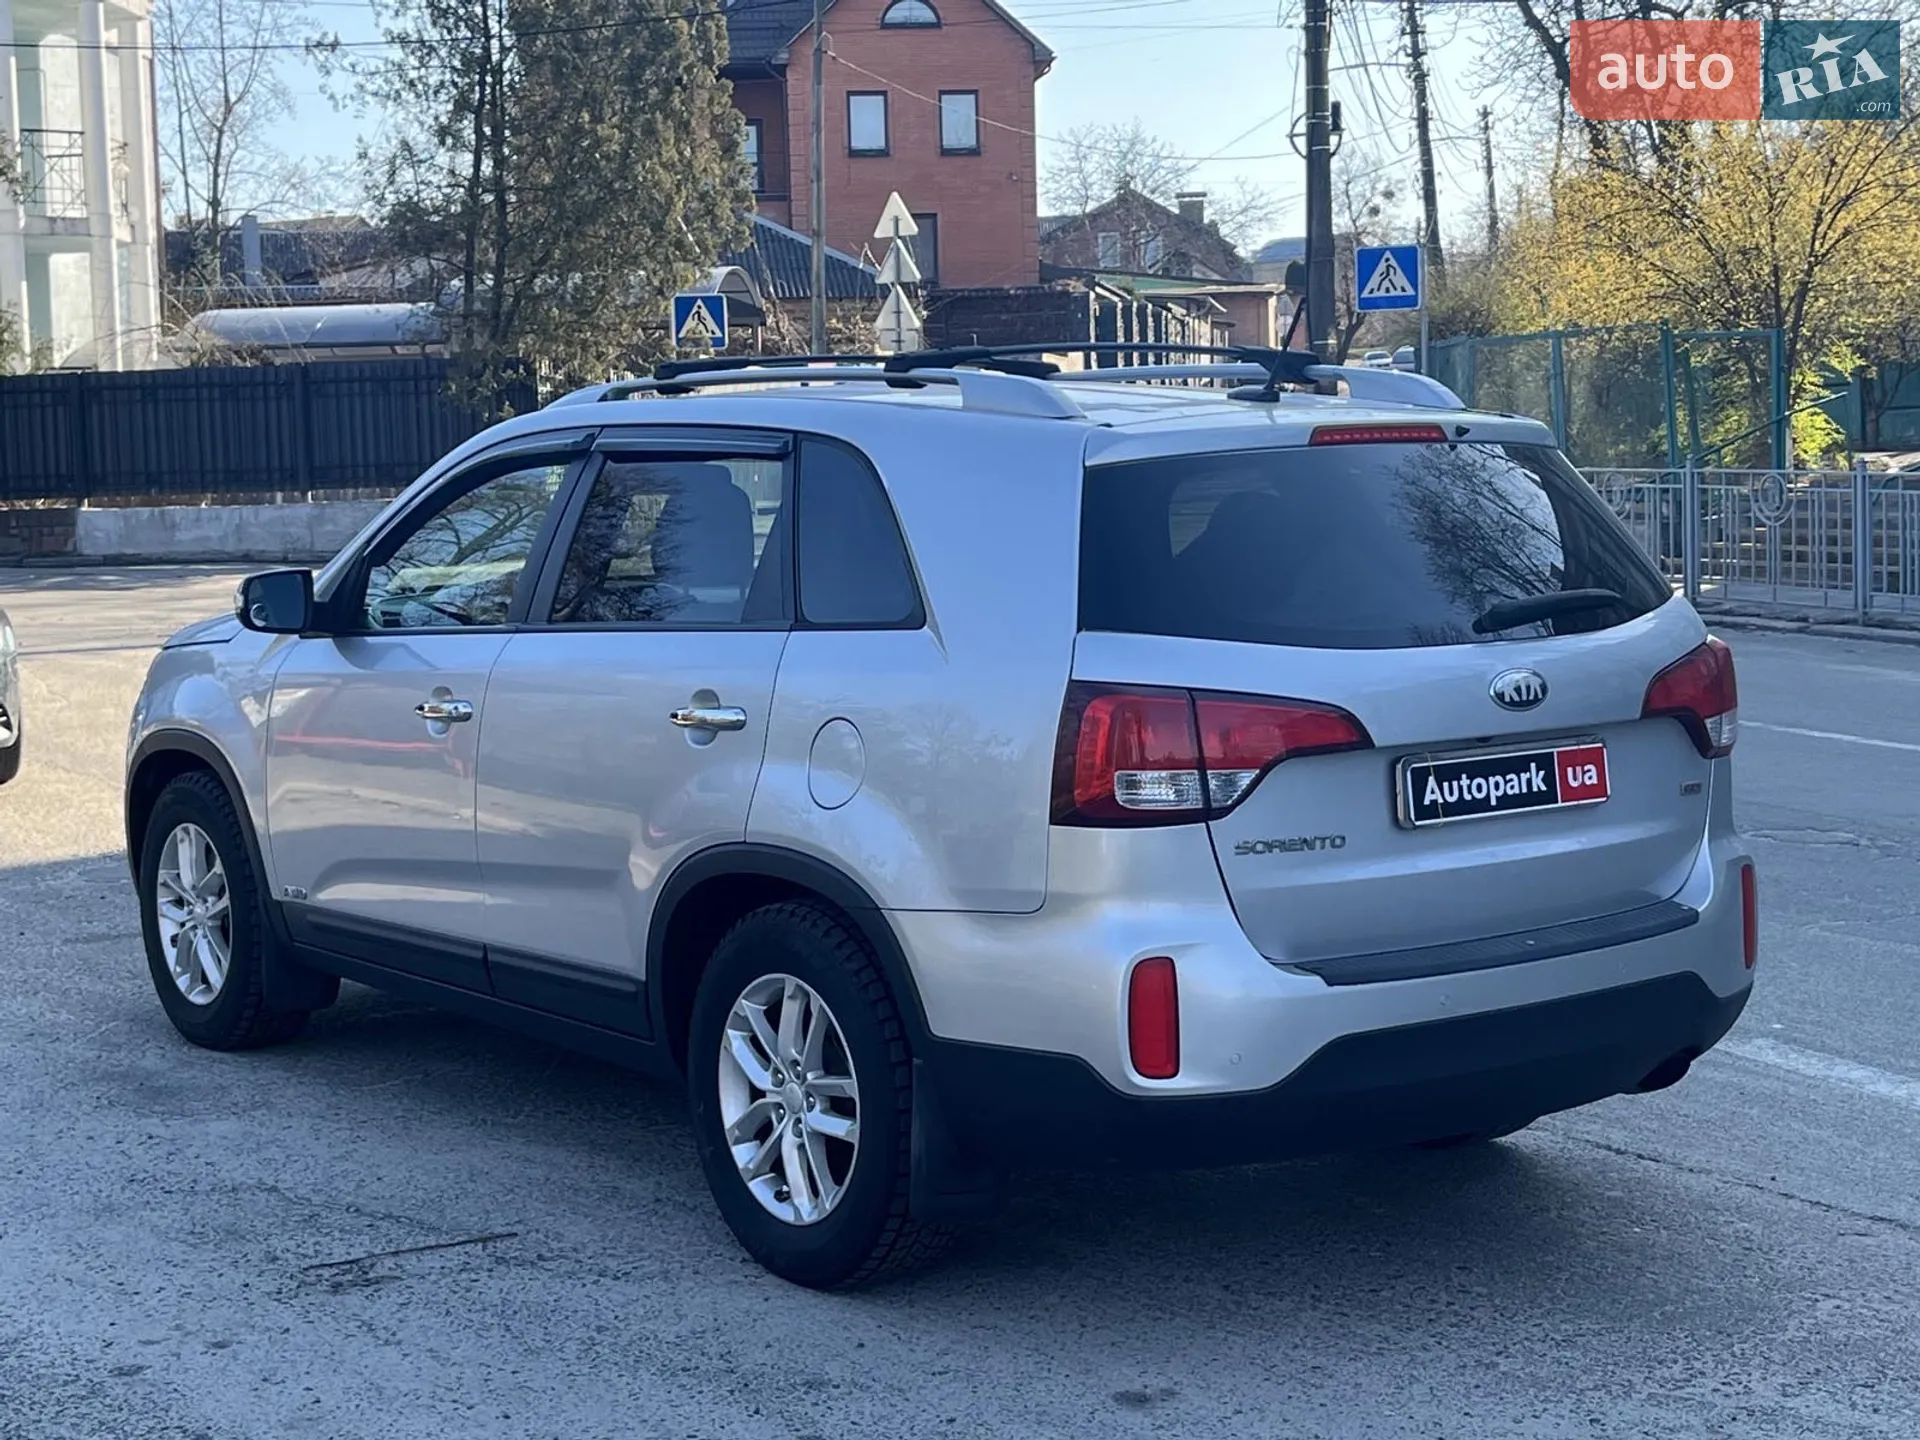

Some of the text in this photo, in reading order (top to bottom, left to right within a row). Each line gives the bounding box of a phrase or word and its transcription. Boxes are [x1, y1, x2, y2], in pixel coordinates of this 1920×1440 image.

[1496, 674, 1543, 702] KIA
[1423, 762, 1599, 806] Autopark ua
[1234, 834, 1346, 856] SORENTO
